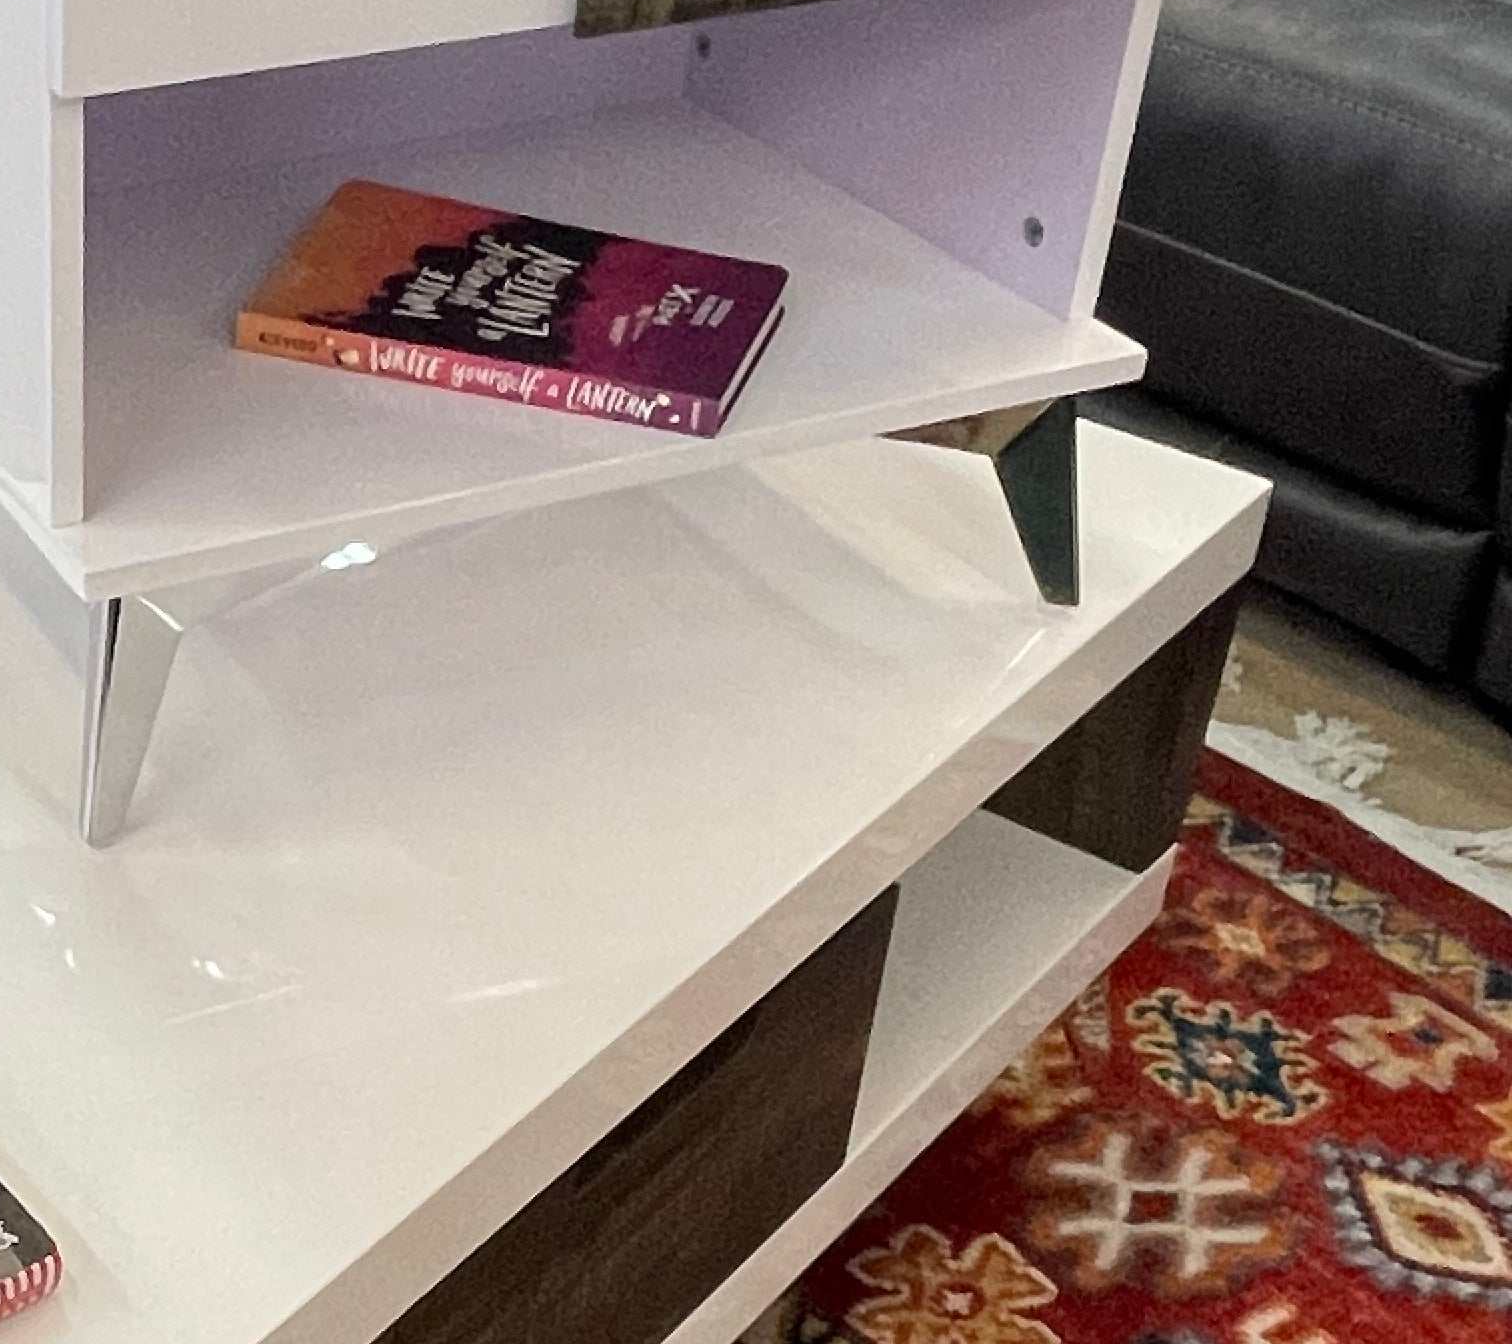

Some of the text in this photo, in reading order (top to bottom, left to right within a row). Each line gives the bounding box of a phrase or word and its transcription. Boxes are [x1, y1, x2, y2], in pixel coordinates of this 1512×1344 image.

[370, 340, 445, 381] WRITE
[450, 362, 544, 404] yourself
[566, 375, 658, 423] LANTERN
